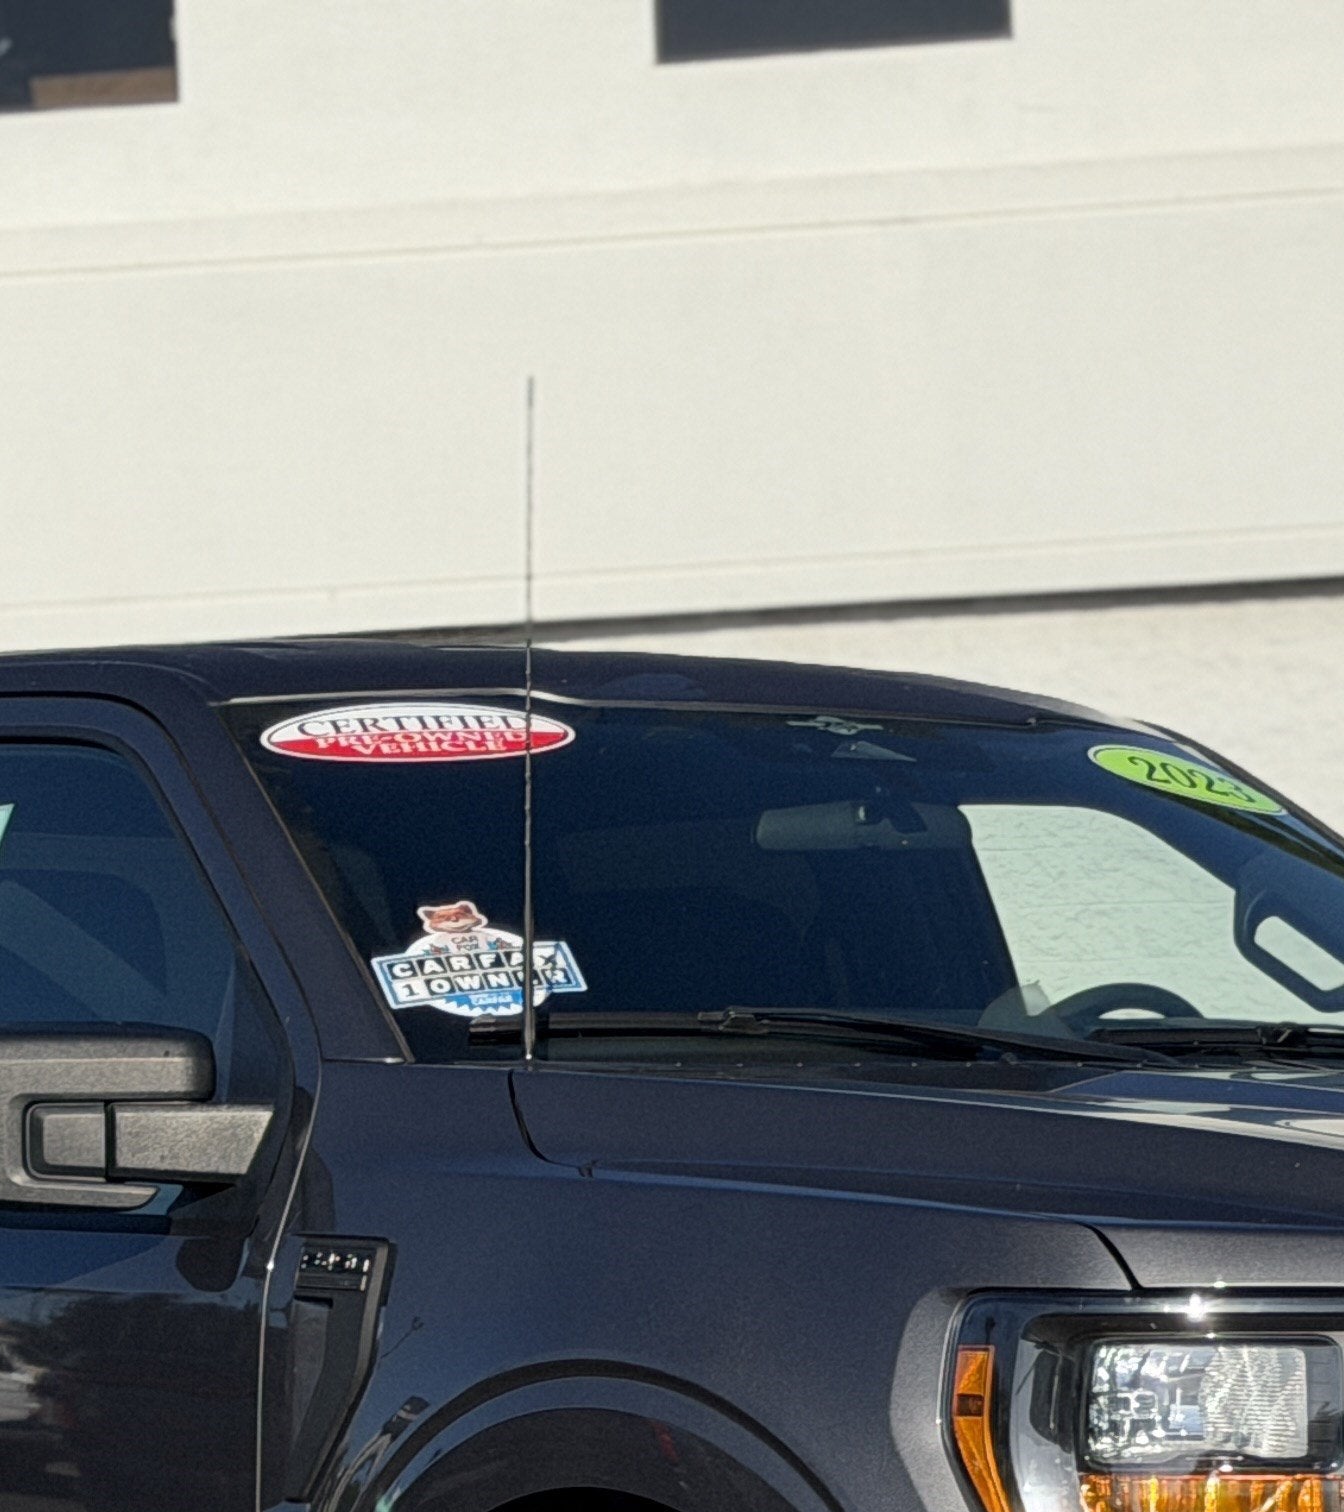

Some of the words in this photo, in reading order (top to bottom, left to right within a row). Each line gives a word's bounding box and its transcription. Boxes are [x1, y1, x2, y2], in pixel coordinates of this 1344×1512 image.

[296, 715, 532, 738] CERTIFIED
[315, 730, 527, 748] PRE-OWNED
[351, 740, 507, 755] VEHICLE
[1127, 755, 1258, 803] 2023
[392, 949, 558, 979] CARFAX
[402, 983, 420, 997] 1
